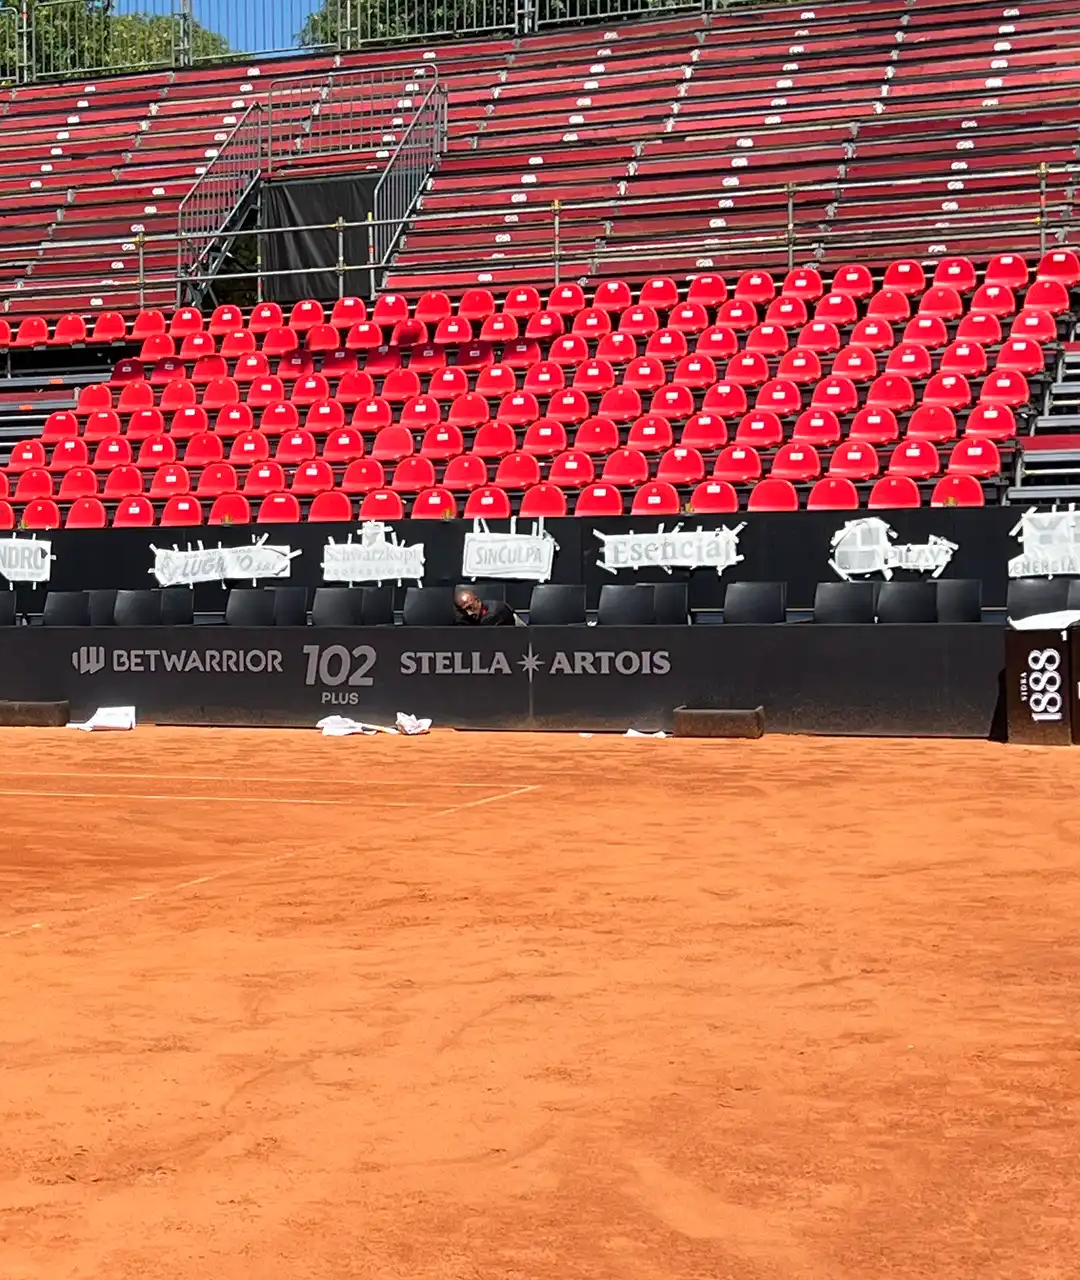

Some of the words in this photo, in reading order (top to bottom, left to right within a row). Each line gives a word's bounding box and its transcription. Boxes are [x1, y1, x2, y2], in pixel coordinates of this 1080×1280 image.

[182, 554, 254, 578] LUGAO
[112, 649, 284, 673] BETWARRIOR
[302, 645, 377, 687] 102
[399, 651, 513, 675] STELLA
[548, 651, 672, 675] ARTOIS
[1027, 647, 1063, 723] 1888
[321, 691, 360, 706] PLUS
